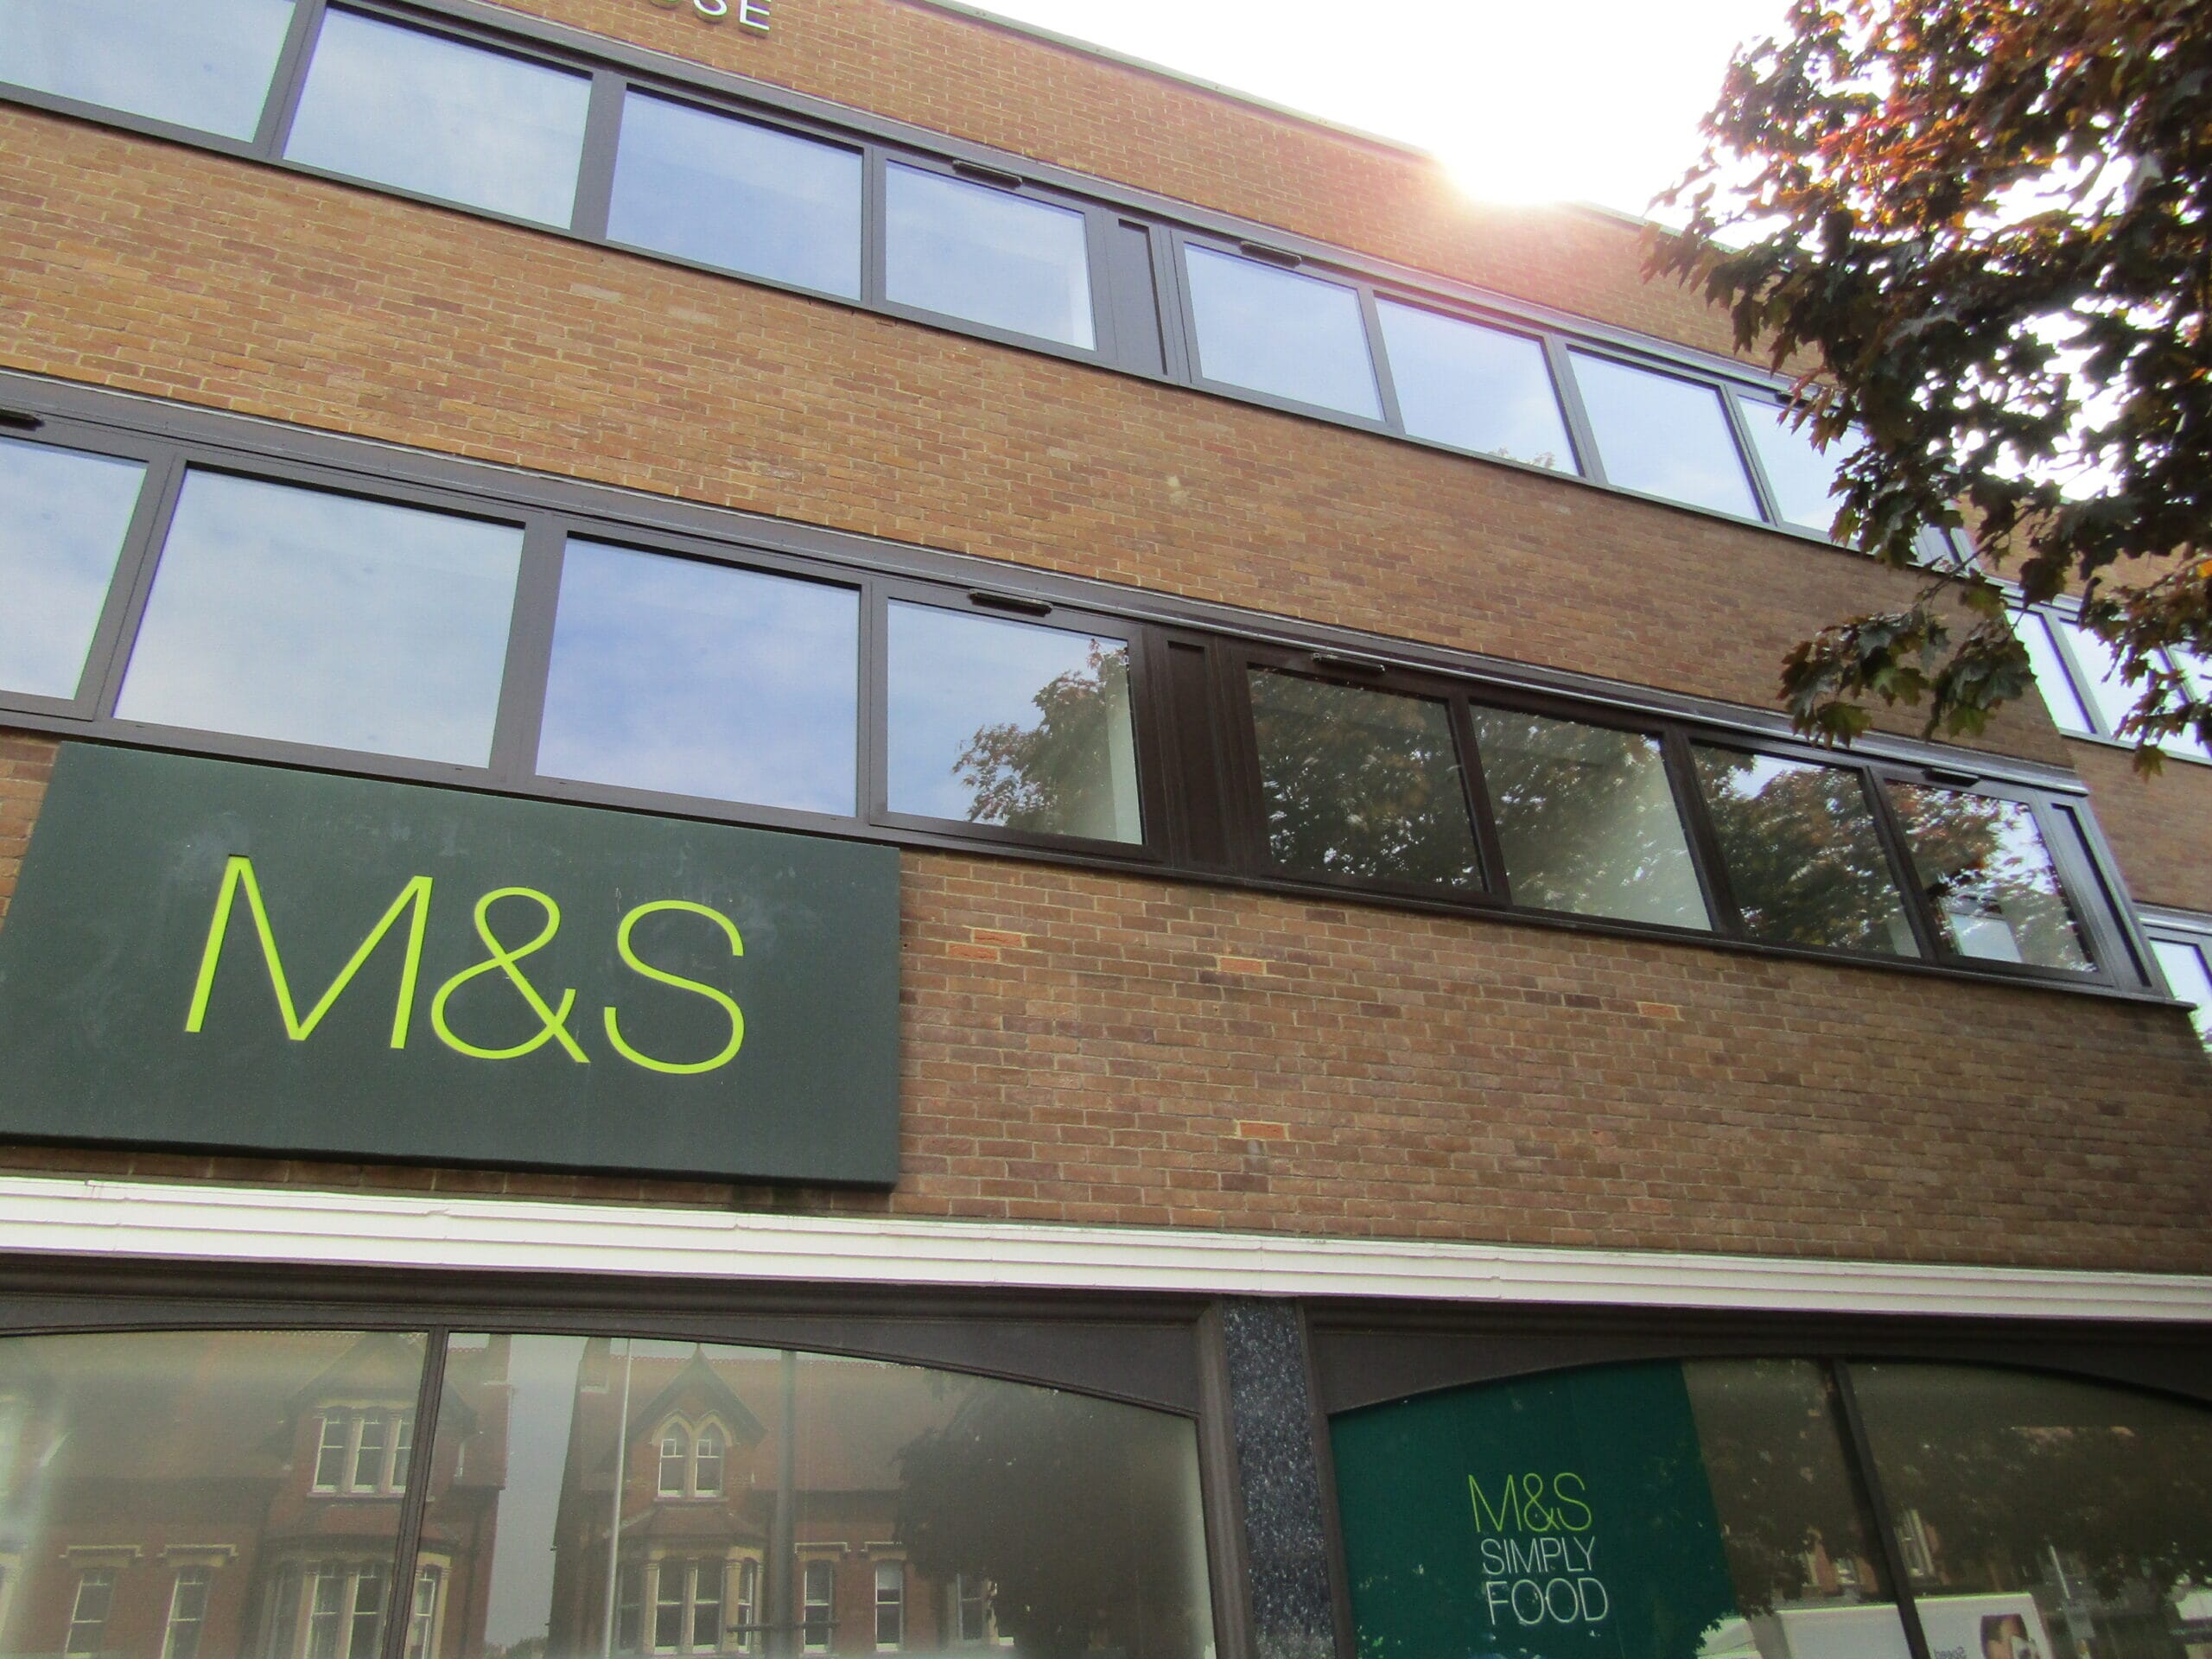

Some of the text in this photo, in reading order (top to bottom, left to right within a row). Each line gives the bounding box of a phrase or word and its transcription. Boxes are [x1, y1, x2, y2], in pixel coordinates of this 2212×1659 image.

[184, 855, 745, 1074] M&S
[1468, 1472, 1592, 1533] M&S
[1480, 1535, 1596, 1575] SIMPLY
[1485, 1577, 1609, 1626] FOOD
